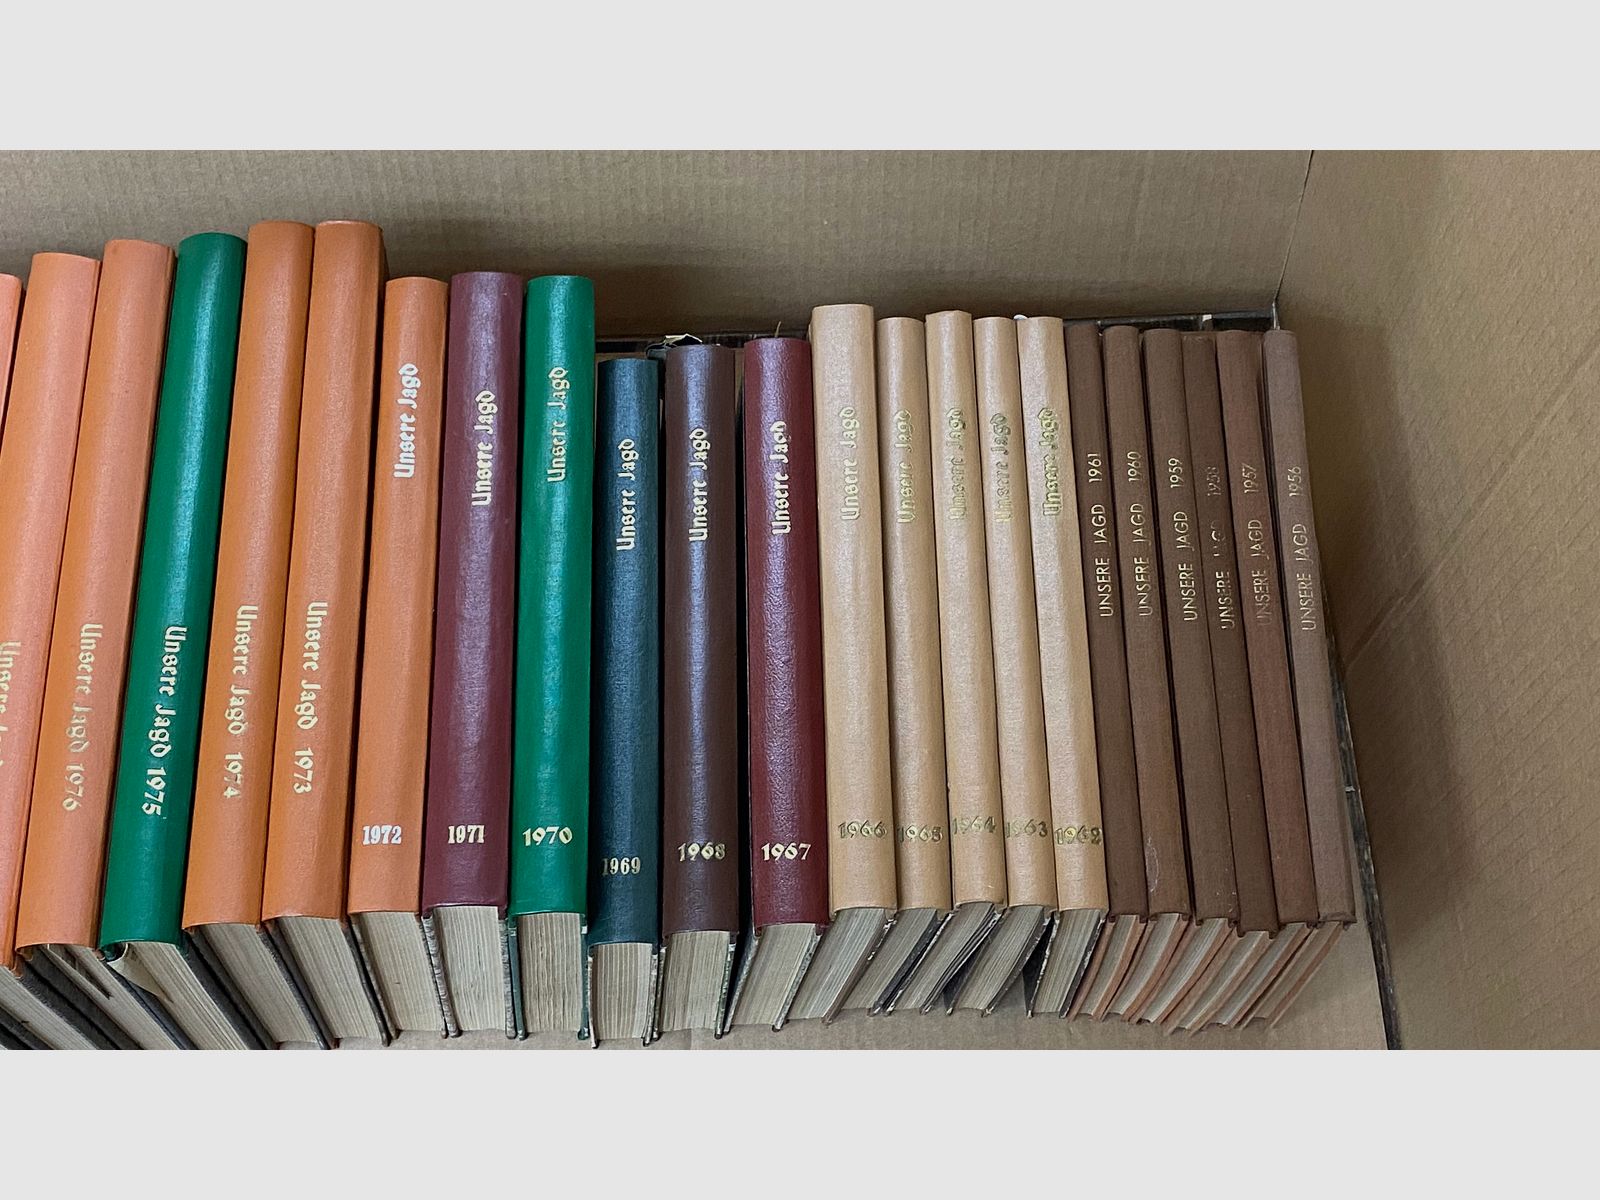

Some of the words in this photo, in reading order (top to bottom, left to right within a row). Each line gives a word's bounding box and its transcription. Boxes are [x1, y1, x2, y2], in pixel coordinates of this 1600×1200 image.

[398, 362, 421, 410] Jagd
[547, 366, 570, 411] Jagd
[474, 389, 498, 435] Jagd
[838, 406, 860, 450] Jagd
[393, 413, 416, 478] Unsere
[547, 417, 568, 483] Unsere
[617, 438, 640, 482] Jagd
[689, 427, 711, 471] Jagd
[770, 420, 793, 464] Jagd
[471, 444, 493, 507] Unsere
[841, 457, 861, 521] Unsere
[947, 455, 967, 521] Unsere
[1042, 454, 1063, 517] Unsere
[1088, 453, 1102, 483] 1961
[1127, 451, 1143, 483] 1960
[1169, 458, 1184, 489] 1959
[1242, 463, 1258, 494] 1957
[1288, 466, 1302, 497] 1956
[689, 475, 710, 543] Unsere
[772, 470, 793, 536] Unsere
[897, 461, 915, 523] Unsere
[994, 461, 1012, 523] Unsere
[616, 487, 637, 551] Unsere
[1091, 504, 1111, 547] JAGD
[1131, 503, 1152, 546] JAGD
[1174, 511, 1195, 552] JAGD
[1248, 519, 1270, 560] JAGD
[1292, 523, 1315, 563] JAGD
[1095, 558, 1114, 618] UNSERE
[1134, 557, 1154, 617] UNSERE
[1178, 563, 1198, 622] UNSERE
[1216, 571, 1235, 629] UNSERE
[1252, 569, 1272, 627] UNSERE
[1297, 573, 1317, 631] UNSERE
[75, 622, 104, 696] Unsere
[232, 604, 259, 676] Unsere
[302, 601, 329, 671] Unsere
[158, 625, 187, 697] Unsere
[65, 702, 93, 753] Jagd
[224, 683, 253, 735] Jagd
[294, 678, 322, 730] Jagd
[147, 703, 177, 758] Jagd
[61, 762, 85, 812] 1976
[141, 766, 166, 816] 1975
[223, 751, 244, 799] 1974
[293, 747, 314, 794] 1973
[361, 825, 402, 846] 1972
[447, 825, 485, 844] 1971
[522, 826, 573, 847] 1970
[838, 820, 886, 838] 1966
[898, 823, 942, 843] 1965
[953, 816, 996, 835] 1964
[1006, 819, 1048, 838] 1963
[1055, 825, 1102, 846] 1962
[602, 857, 641, 876] 1969
[678, 842, 726, 862] 1968
[761, 842, 811, 861] 1967
